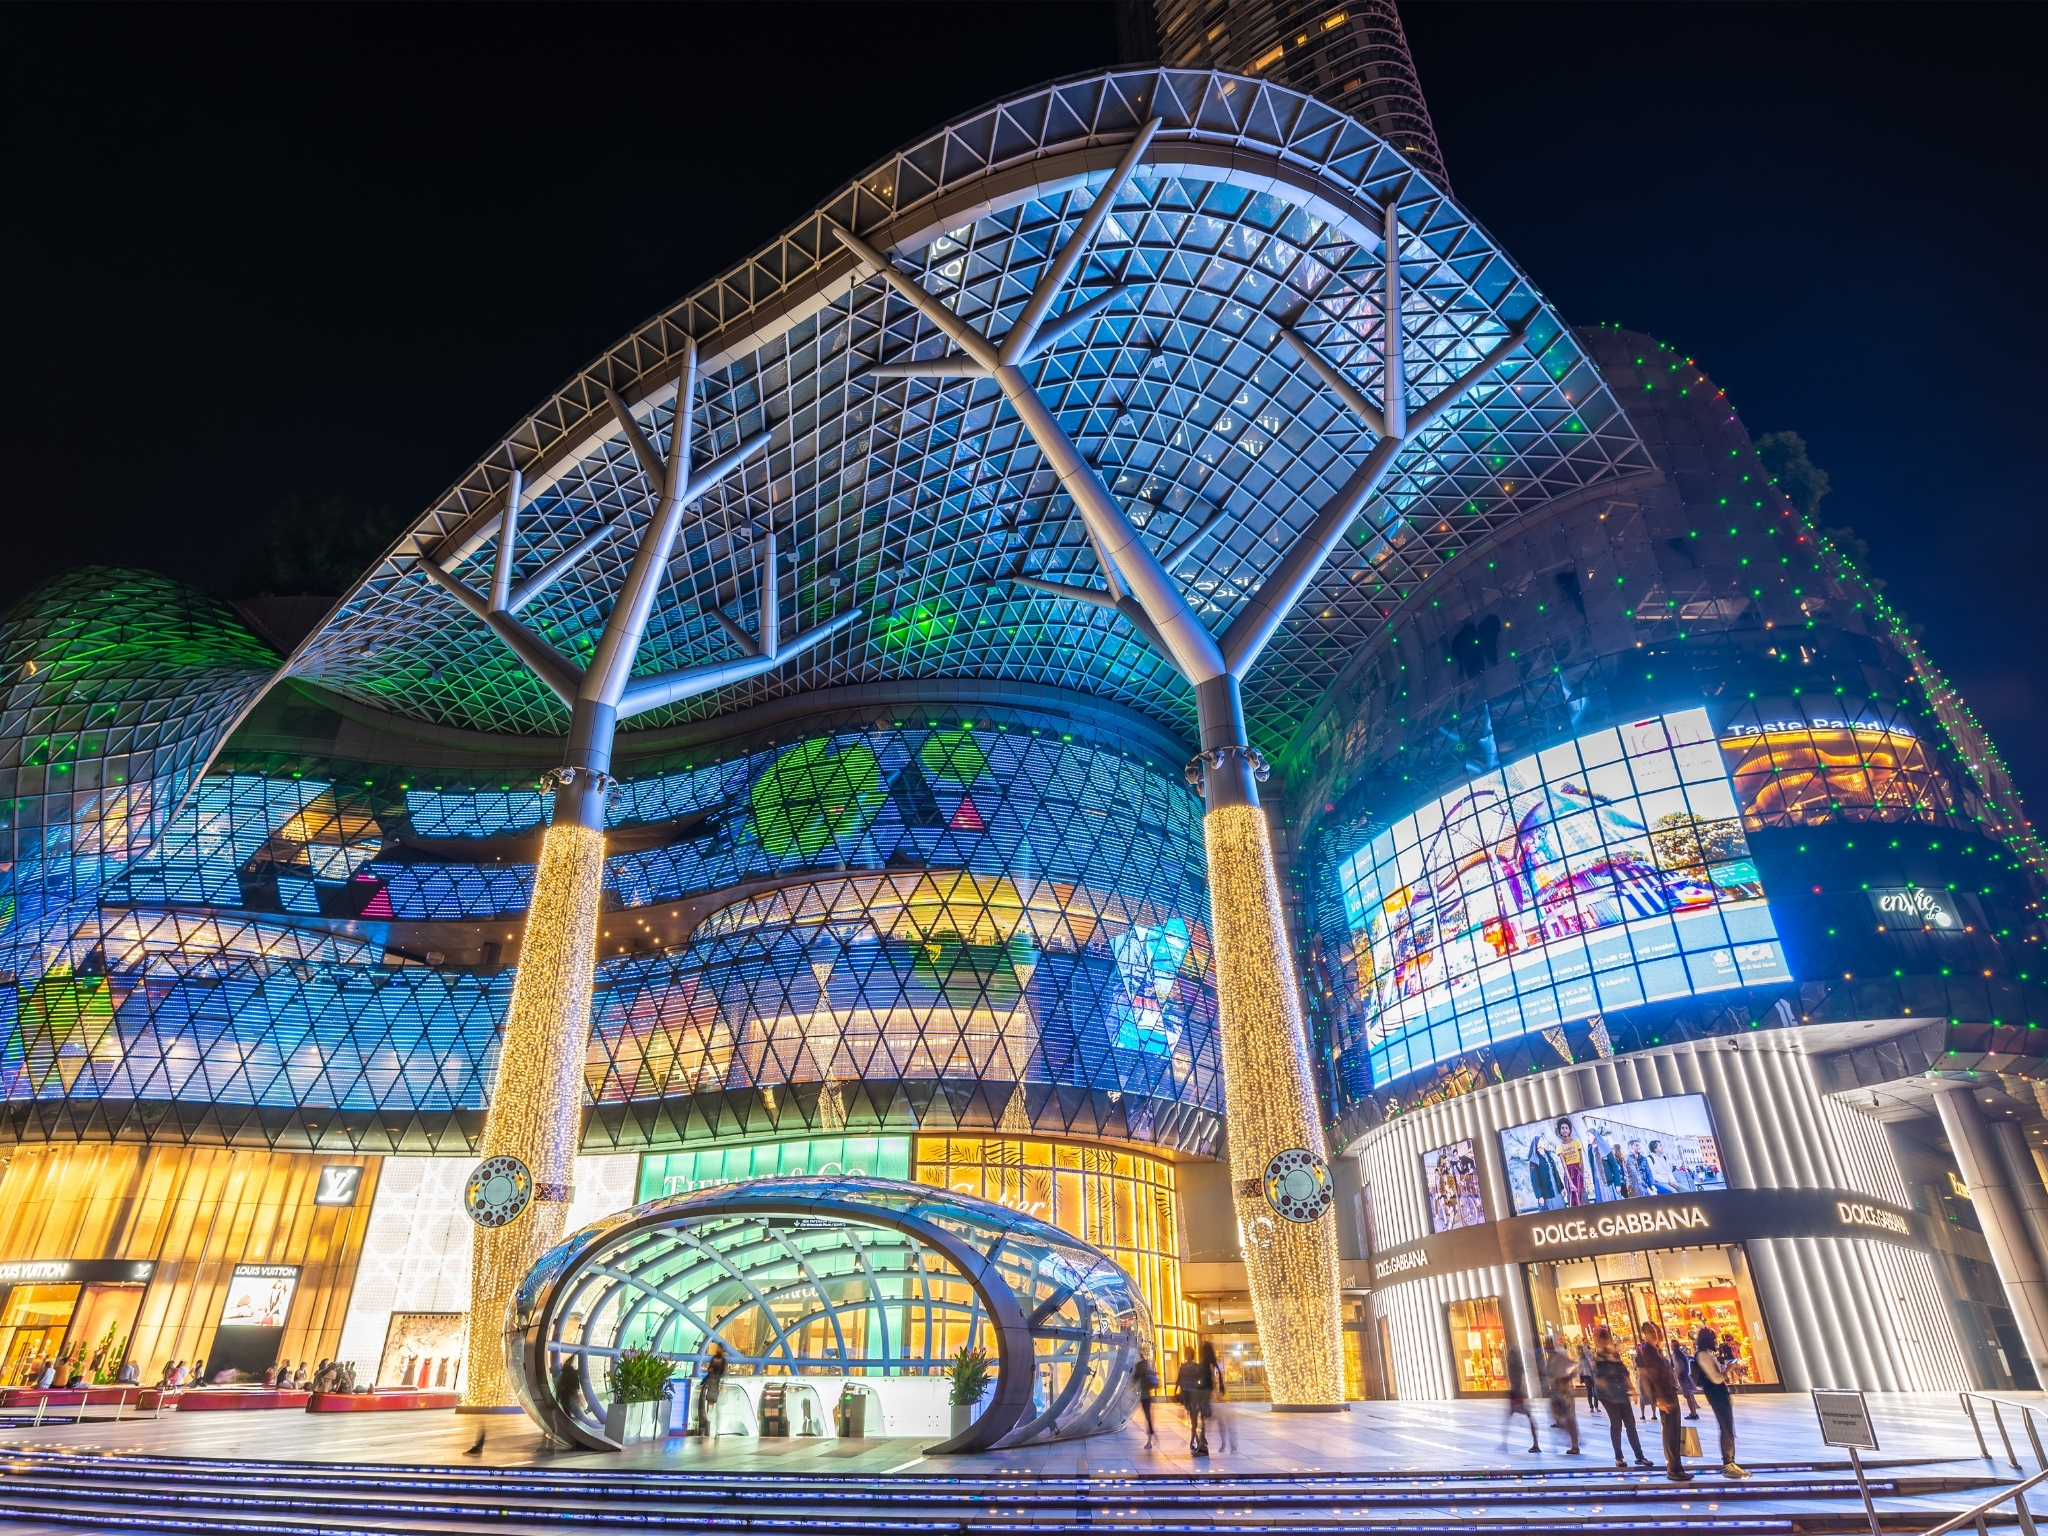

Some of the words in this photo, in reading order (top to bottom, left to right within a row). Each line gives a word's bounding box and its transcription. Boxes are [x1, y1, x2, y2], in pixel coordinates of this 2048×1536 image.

[1728, 720, 1802, 736] Taste
[1813, 719, 1911, 736] Paadse
[1733, 944, 1775, 963] BCA
[1532, 1220, 1589, 1246] DOLCE
[1589, 1228, 1599, 1239] &
[1598, 1207, 1710, 1237] GABBANA
[1391, 1249, 1428, 1273] GABBANA
[0, 1264, 21, 1278] OUIS
[21, 1263, 69, 1277] VUITTON
[235, 1266, 260, 1276] LOUIS
[261, 1267, 297, 1277] VUITTON
